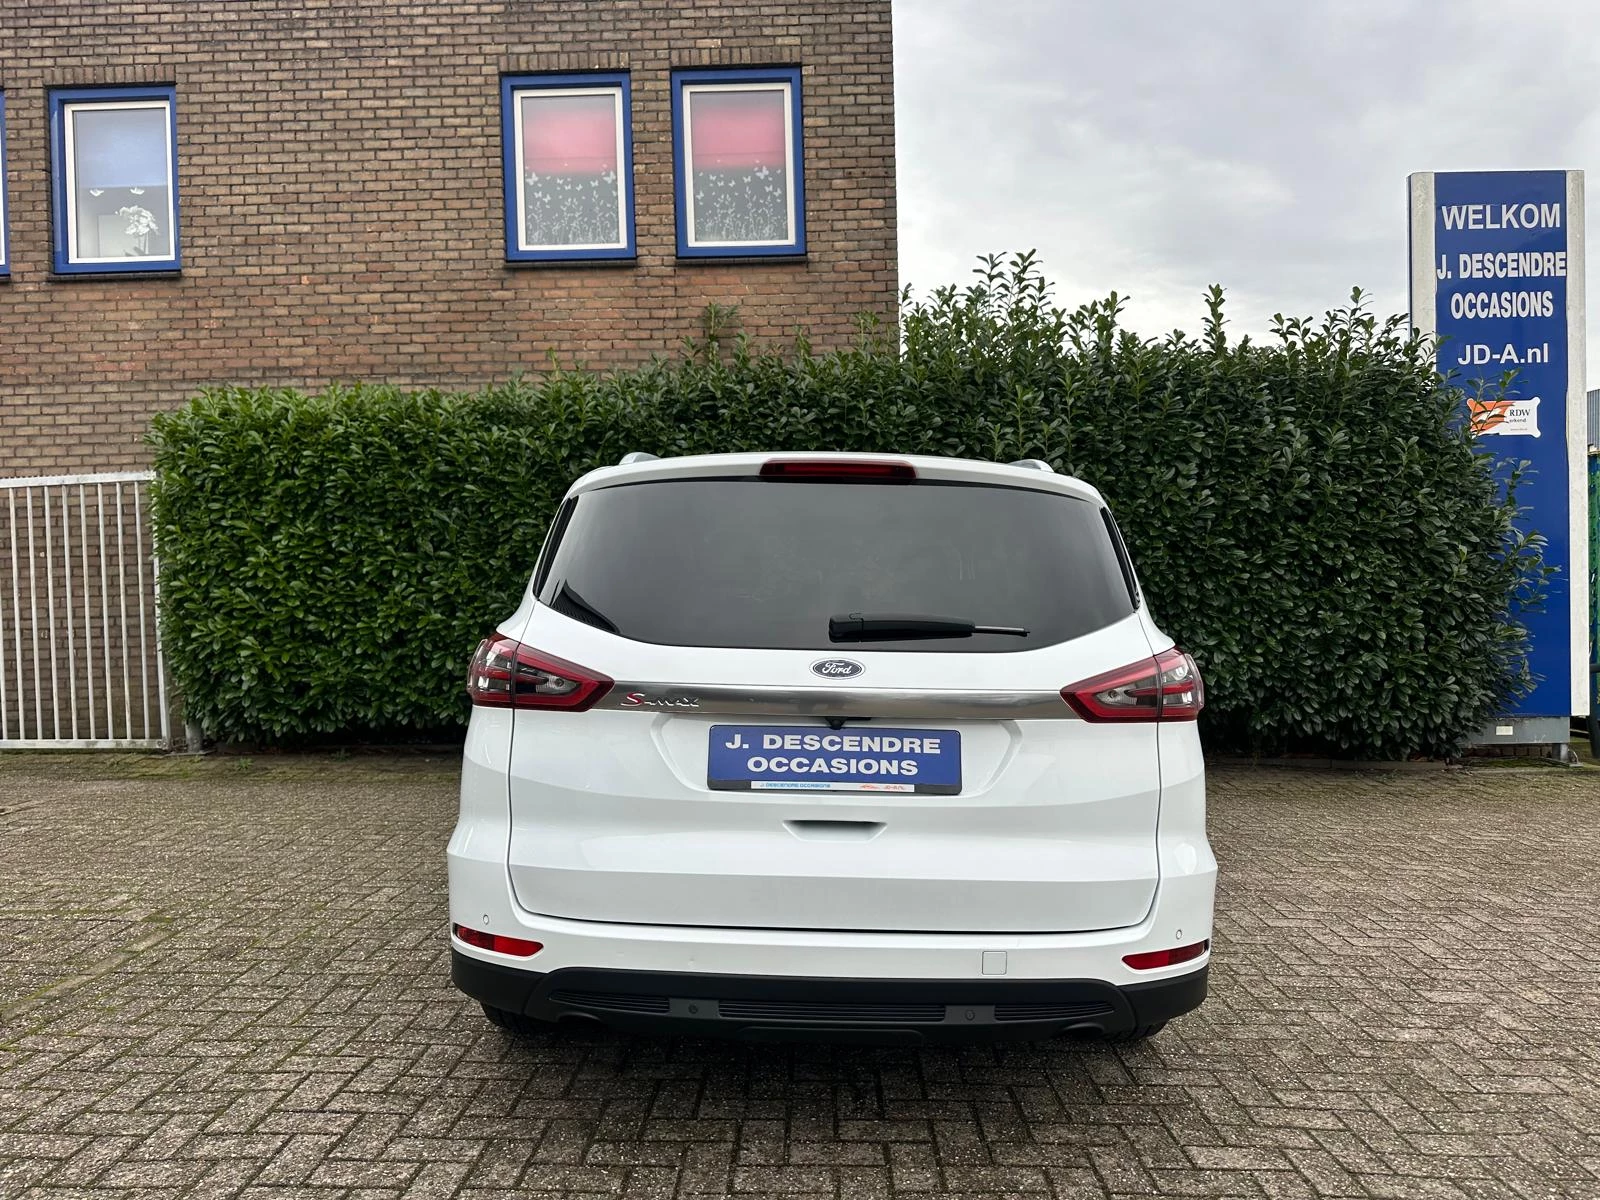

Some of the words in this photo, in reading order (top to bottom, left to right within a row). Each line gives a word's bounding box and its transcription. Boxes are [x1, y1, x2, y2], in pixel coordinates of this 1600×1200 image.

[1442, 203, 1561, 230] WELKOM
[1437, 255, 1451, 279] J.
[1459, 252, 1567, 278] DESCENDRE
[1450, 291, 1554, 319] OCCASIONS
[1457, 343, 1549, 364] JD-A.nl
[822, 662, 852, 673] Ford
[725, 734, 749, 749] J.
[763, 734, 941, 754] DESCENDRE
[747, 756, 919, 775] OCCASIONS
